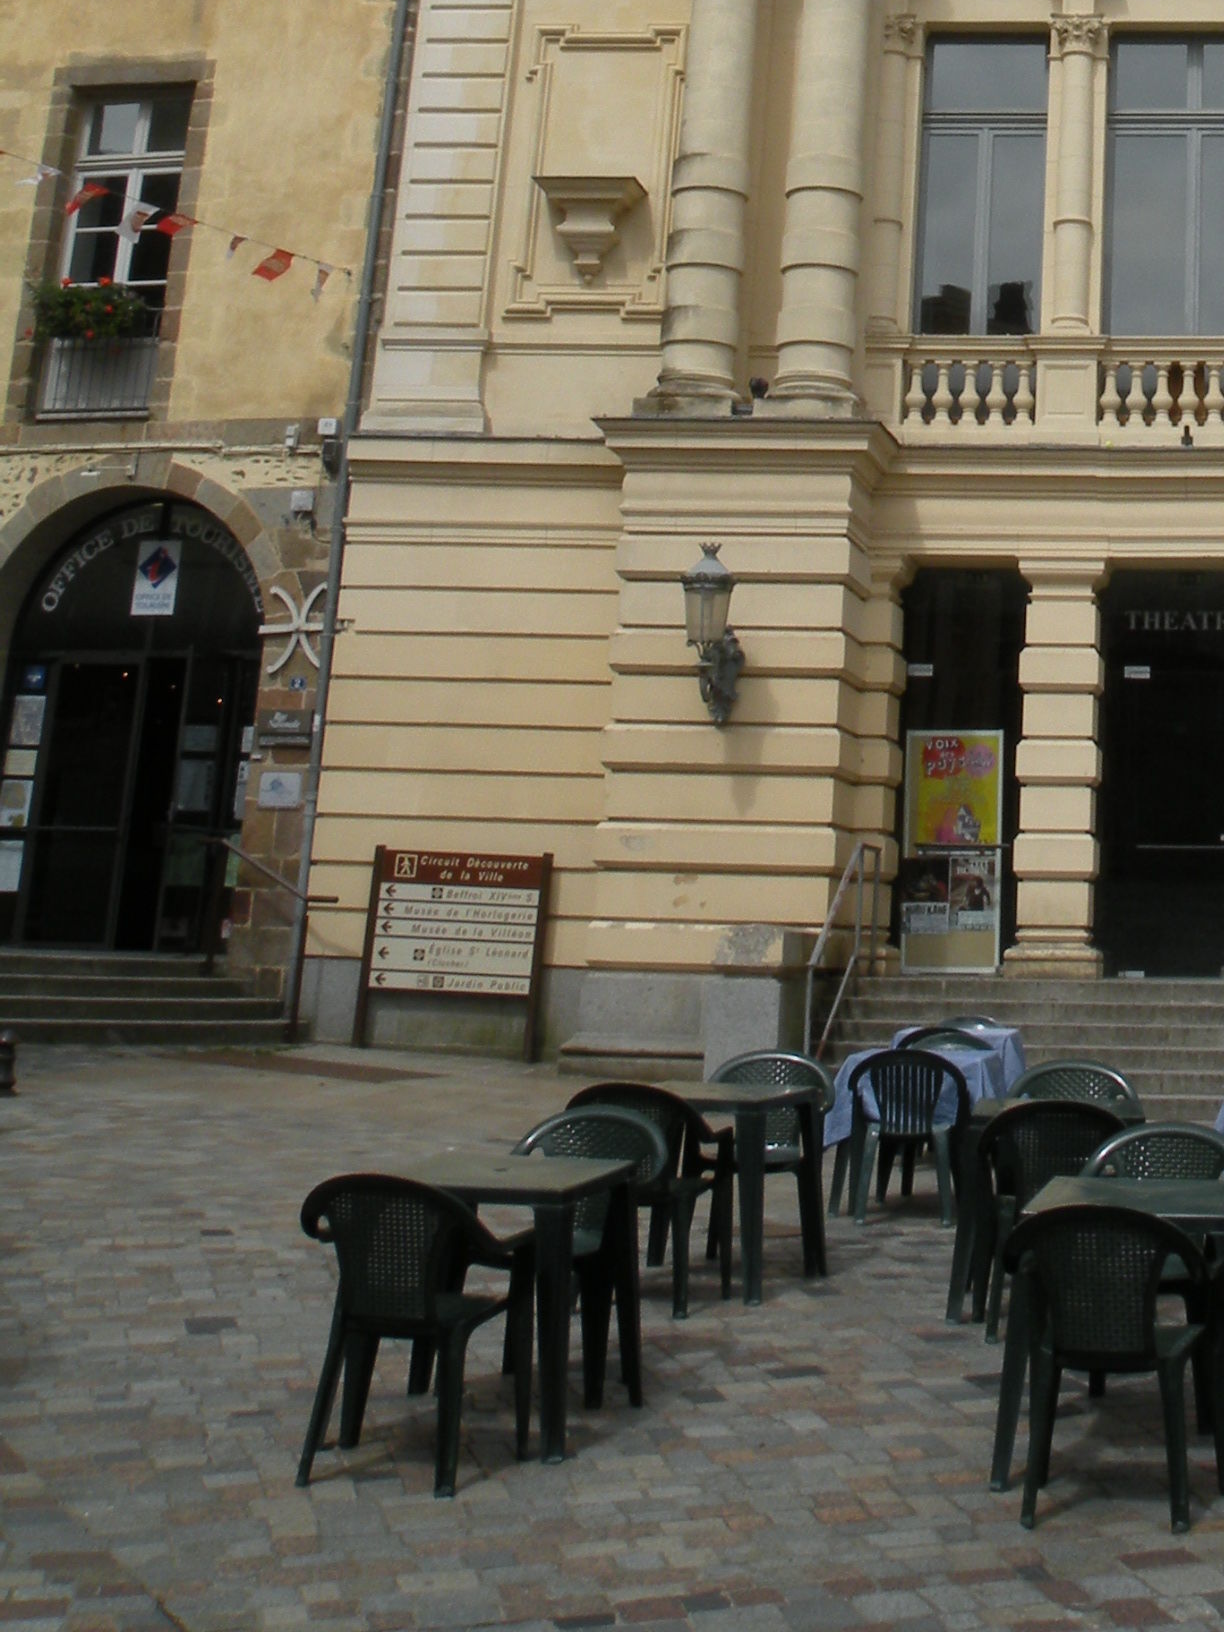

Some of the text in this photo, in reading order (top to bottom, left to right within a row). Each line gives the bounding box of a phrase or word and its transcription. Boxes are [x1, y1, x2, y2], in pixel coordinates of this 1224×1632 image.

[41, 515, 265, 613] OFFICE DE TOURISME
[420, 855, 529, 871] Circuit Découverte
[440, 869, 504, 883] de la Ville
[404, 905, 439, 916] Musée
[447, 906, 459, 917] de
[411, 923, 448, 934] Musée
[455, 925, 467, 936] de
[473, 926, 483, 937] la
[448, 977, 526, 992] Jardin Public
